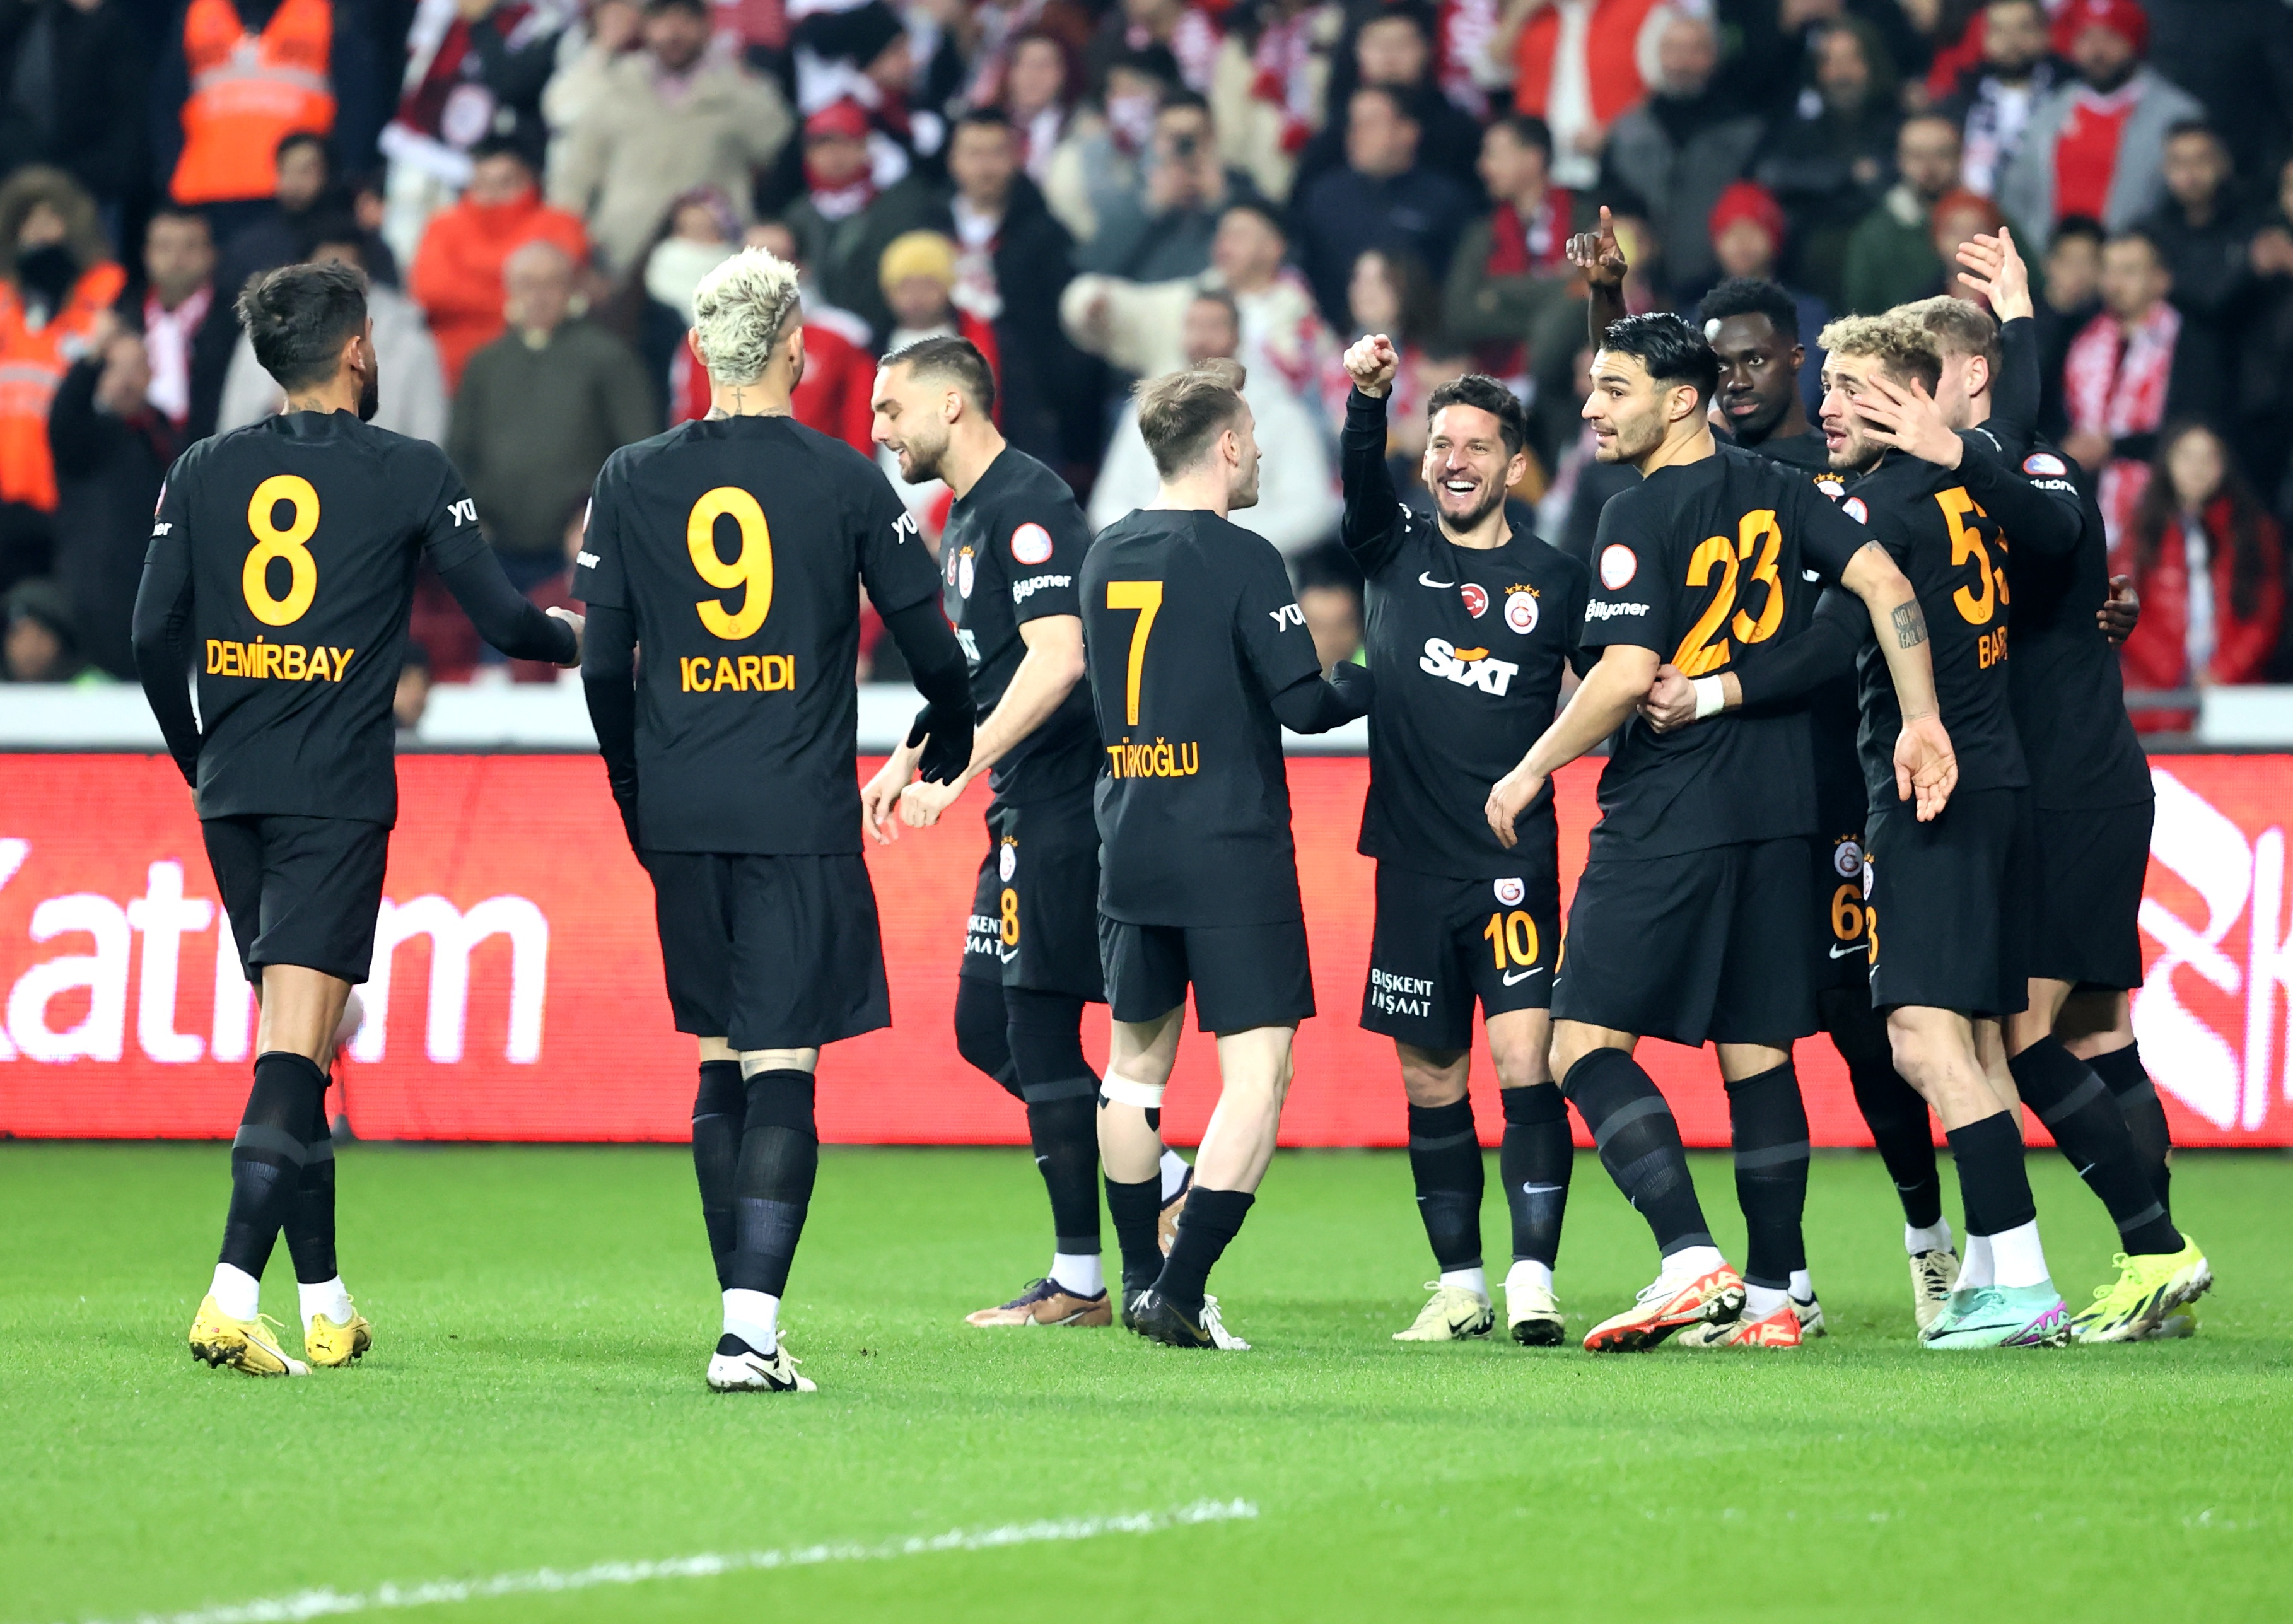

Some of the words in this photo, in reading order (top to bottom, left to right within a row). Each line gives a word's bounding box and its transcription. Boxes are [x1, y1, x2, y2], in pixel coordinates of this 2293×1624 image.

[242, 474, 320, 626] 8
[687, 486, 773, 640] 9
[1584, 599, 1650, 622] Bilyoner
[1671, 509, 1785, 678] 23
[206, 634, 354, 682] DEMİRBAY
[680, 655, 795, 692] ICARDI
[1106, 581, 1163, 726] 7
[1107, 736, 1199, 780] TÜRKOĞLU
[1000, 887, 1019, 946] 8
[1483, 910, 1540, 970] 10
[1831, 884, 1864, 940] 6
[1371, 967, 1435, 997] BAŞKENT
